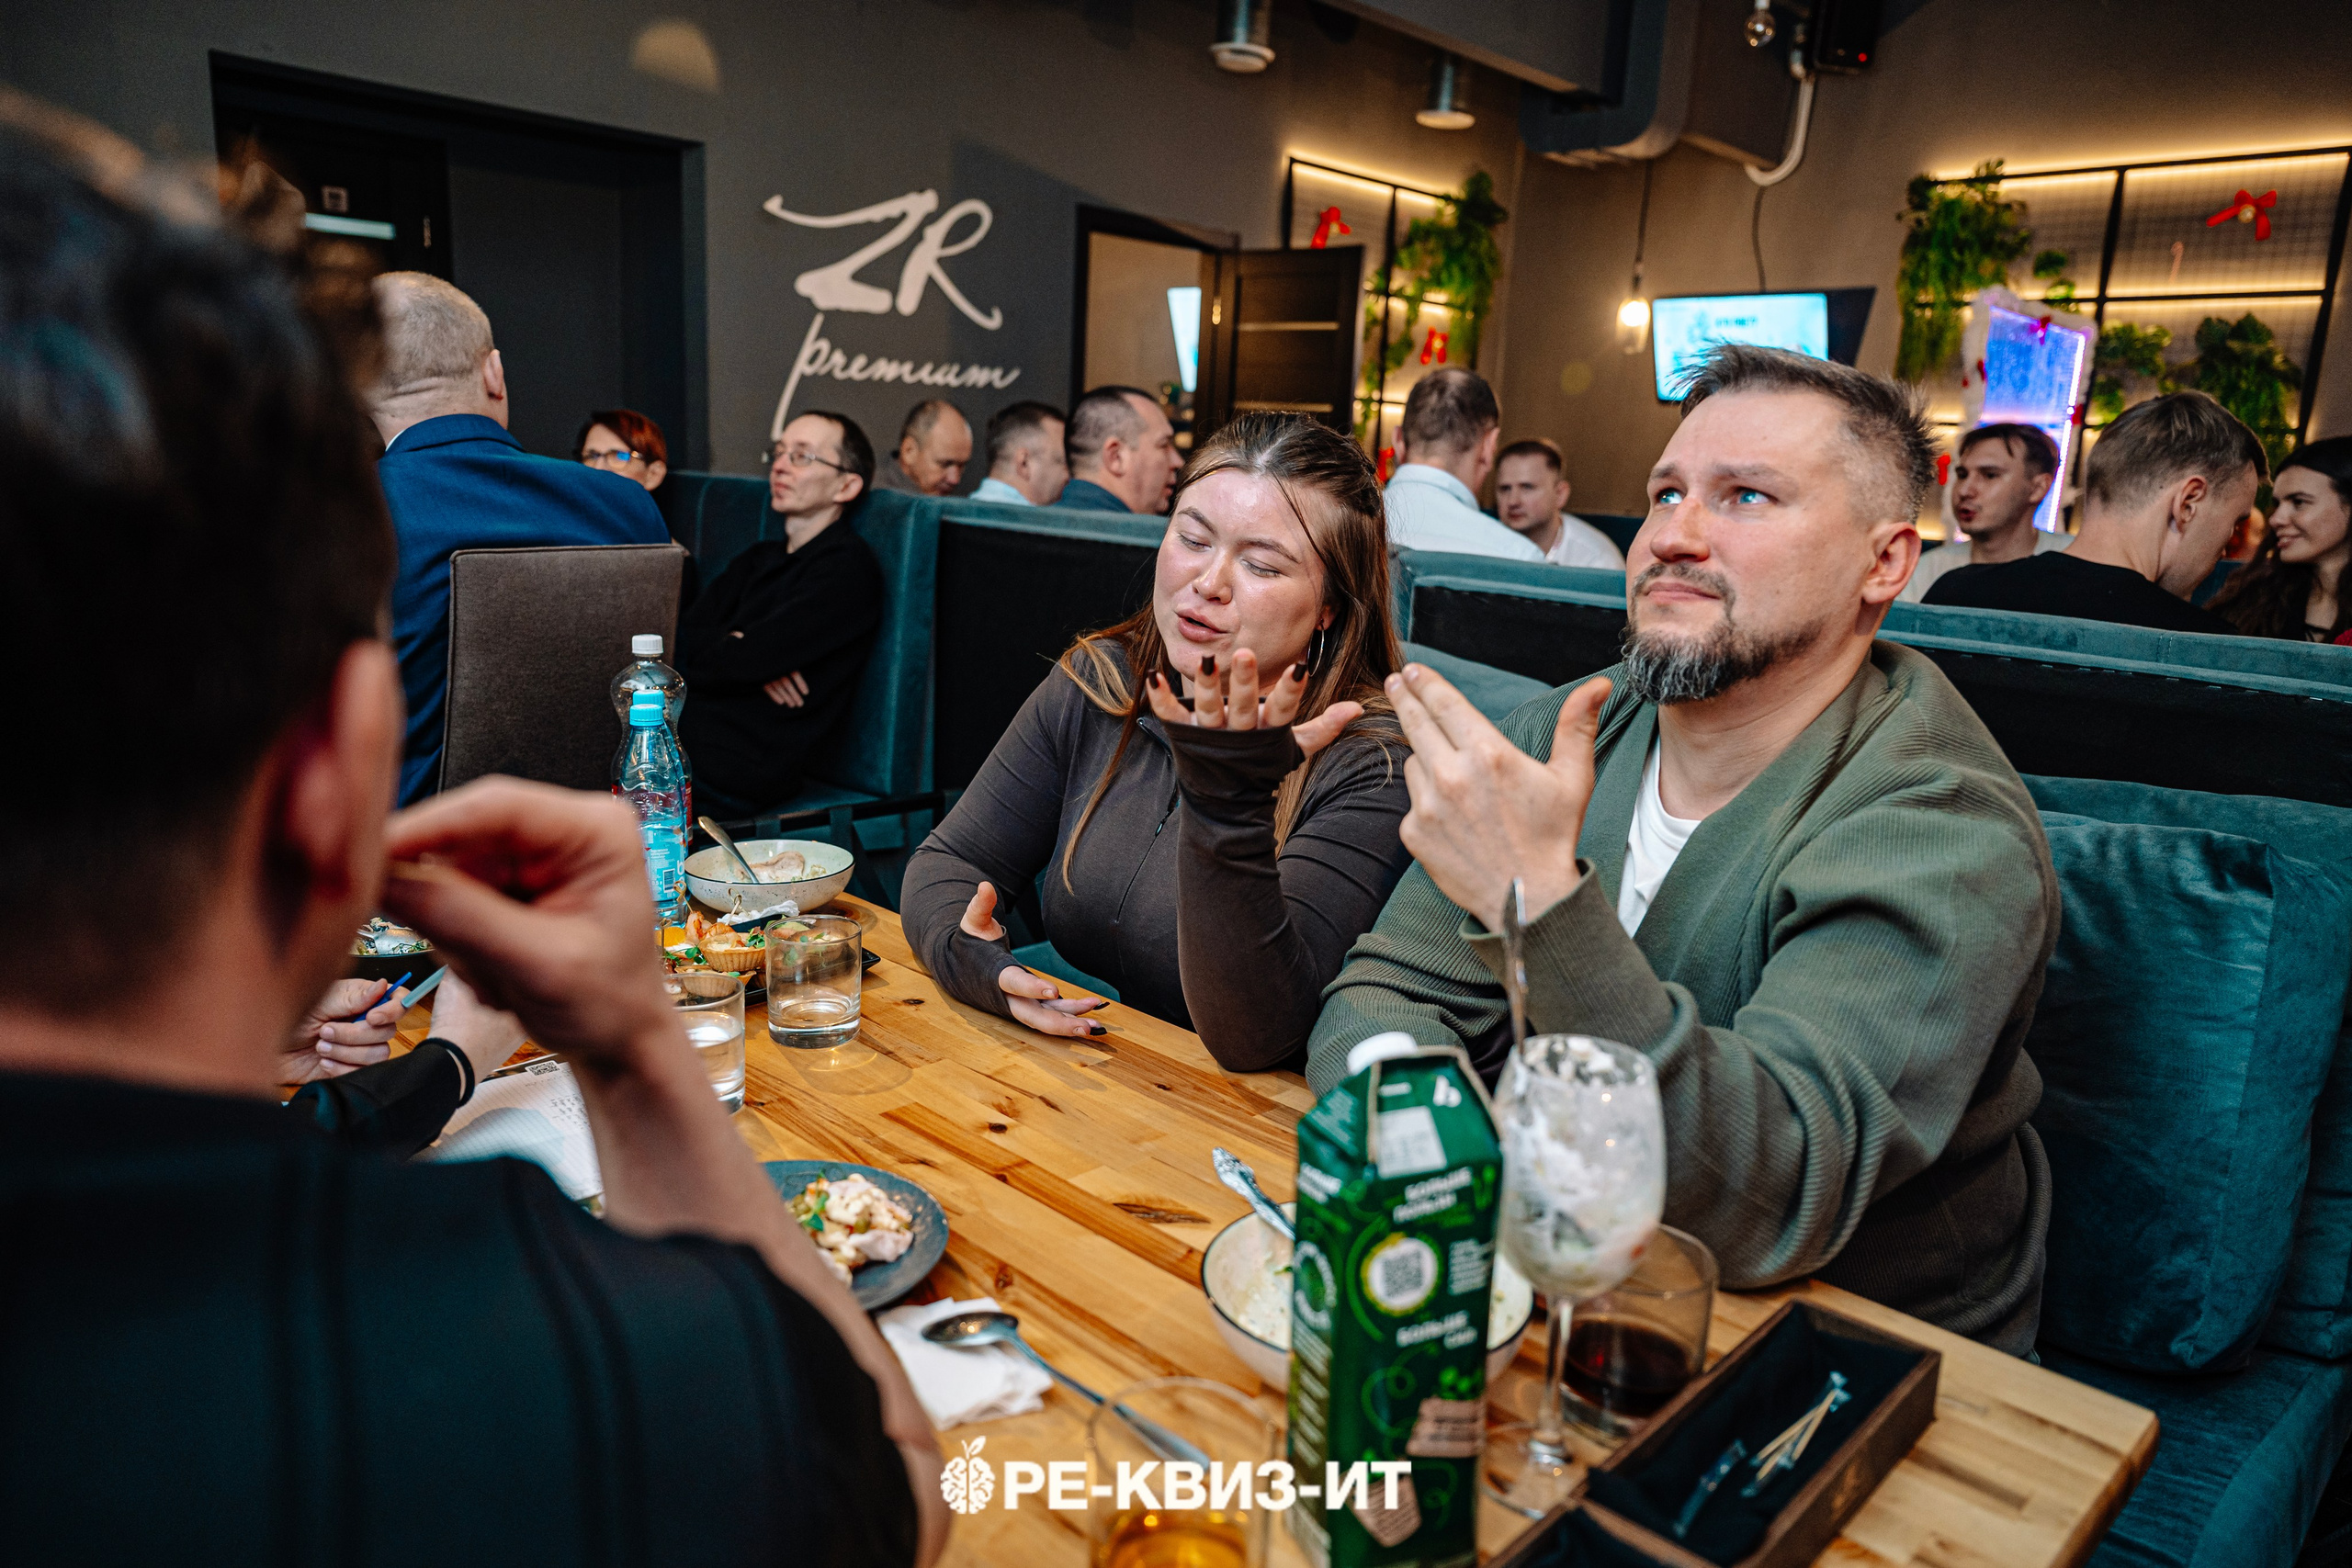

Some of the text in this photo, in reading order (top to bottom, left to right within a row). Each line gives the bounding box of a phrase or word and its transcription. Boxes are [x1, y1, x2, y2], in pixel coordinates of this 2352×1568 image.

[763, 188, 1003, 331] ZR
[771, 311, 1021, 441] premium
[1406, 1168, 1472, 1201] БОЛЬШЕ
[1396, 1311, 1469, 1348] БОЛЬШЕ
